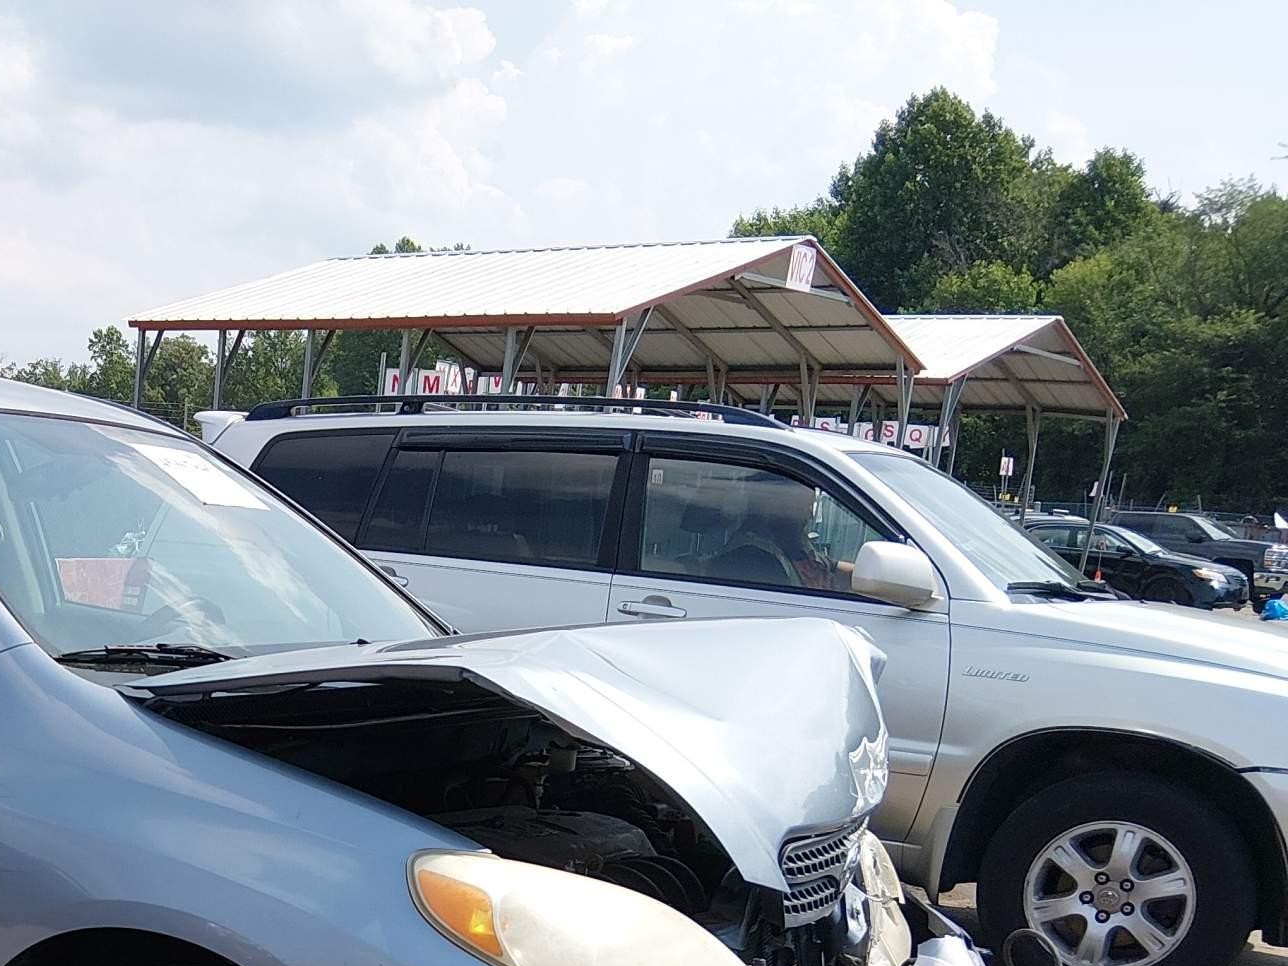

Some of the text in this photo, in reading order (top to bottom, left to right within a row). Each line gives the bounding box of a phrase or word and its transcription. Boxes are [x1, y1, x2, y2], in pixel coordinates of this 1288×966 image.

[423, 375, 441, 394] M
[883, 425, 894, 438] S
[910, 429, 922, 443] Q
[961, 665, 1031, 683] LIMITED
